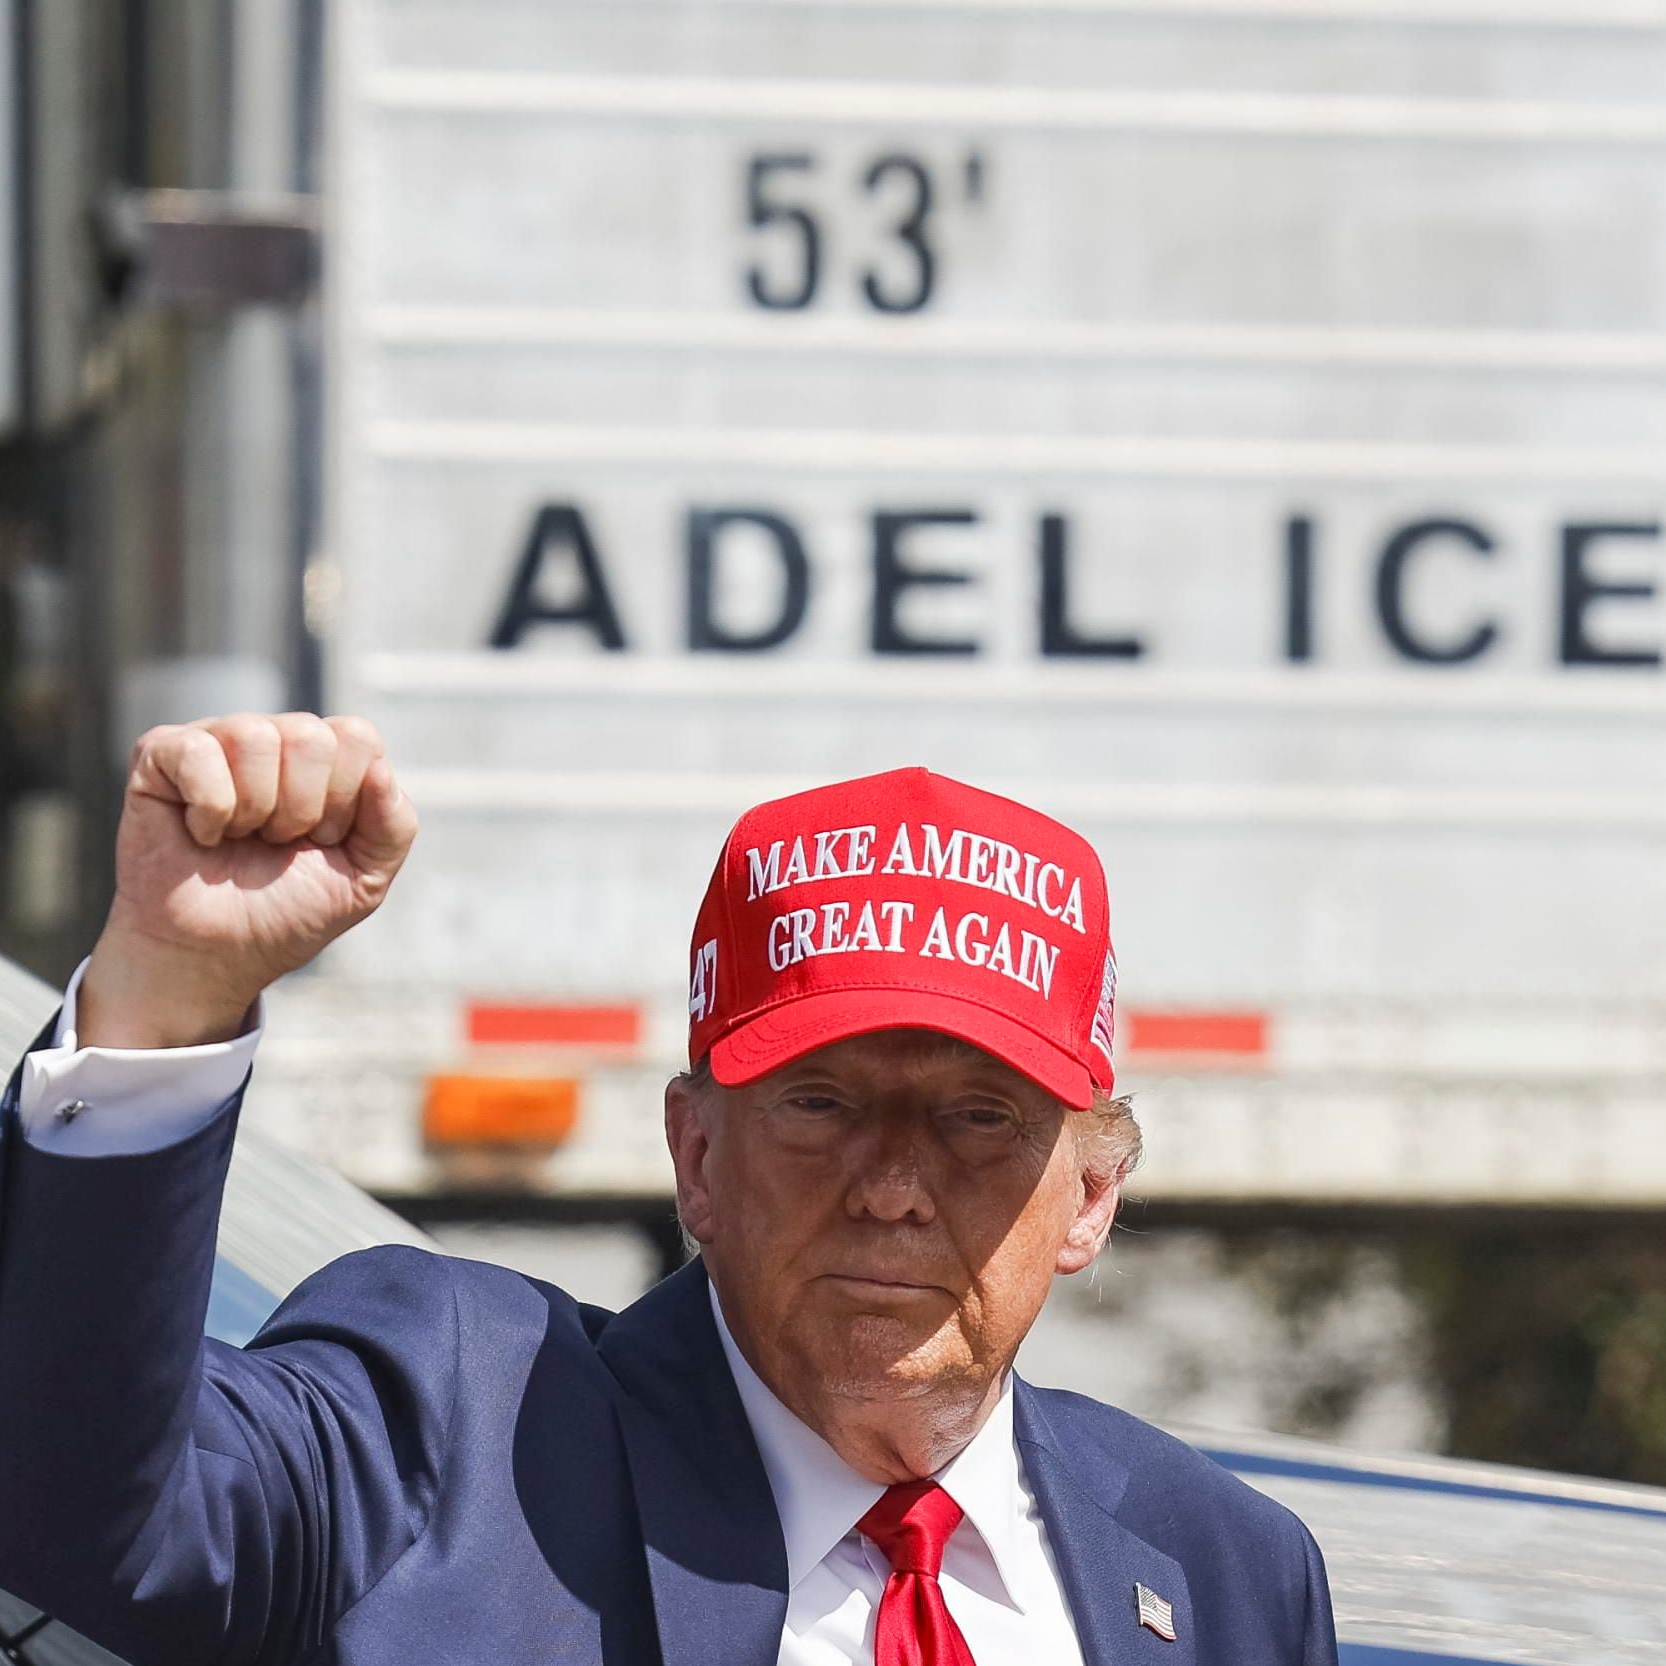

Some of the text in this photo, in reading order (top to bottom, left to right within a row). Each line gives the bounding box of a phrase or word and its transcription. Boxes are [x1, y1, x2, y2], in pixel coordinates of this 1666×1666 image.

[744, 152, 983, 316] 53'
[483, 499, 1149, 663] ADEL
[1282, 512, 1665, 671] ICE
[746, 822, 1087, 935] MAKE AMERICA
[689, 938, 718, 1022] 47
[767, 900, 1062, 1001] GREAT AGAIN
